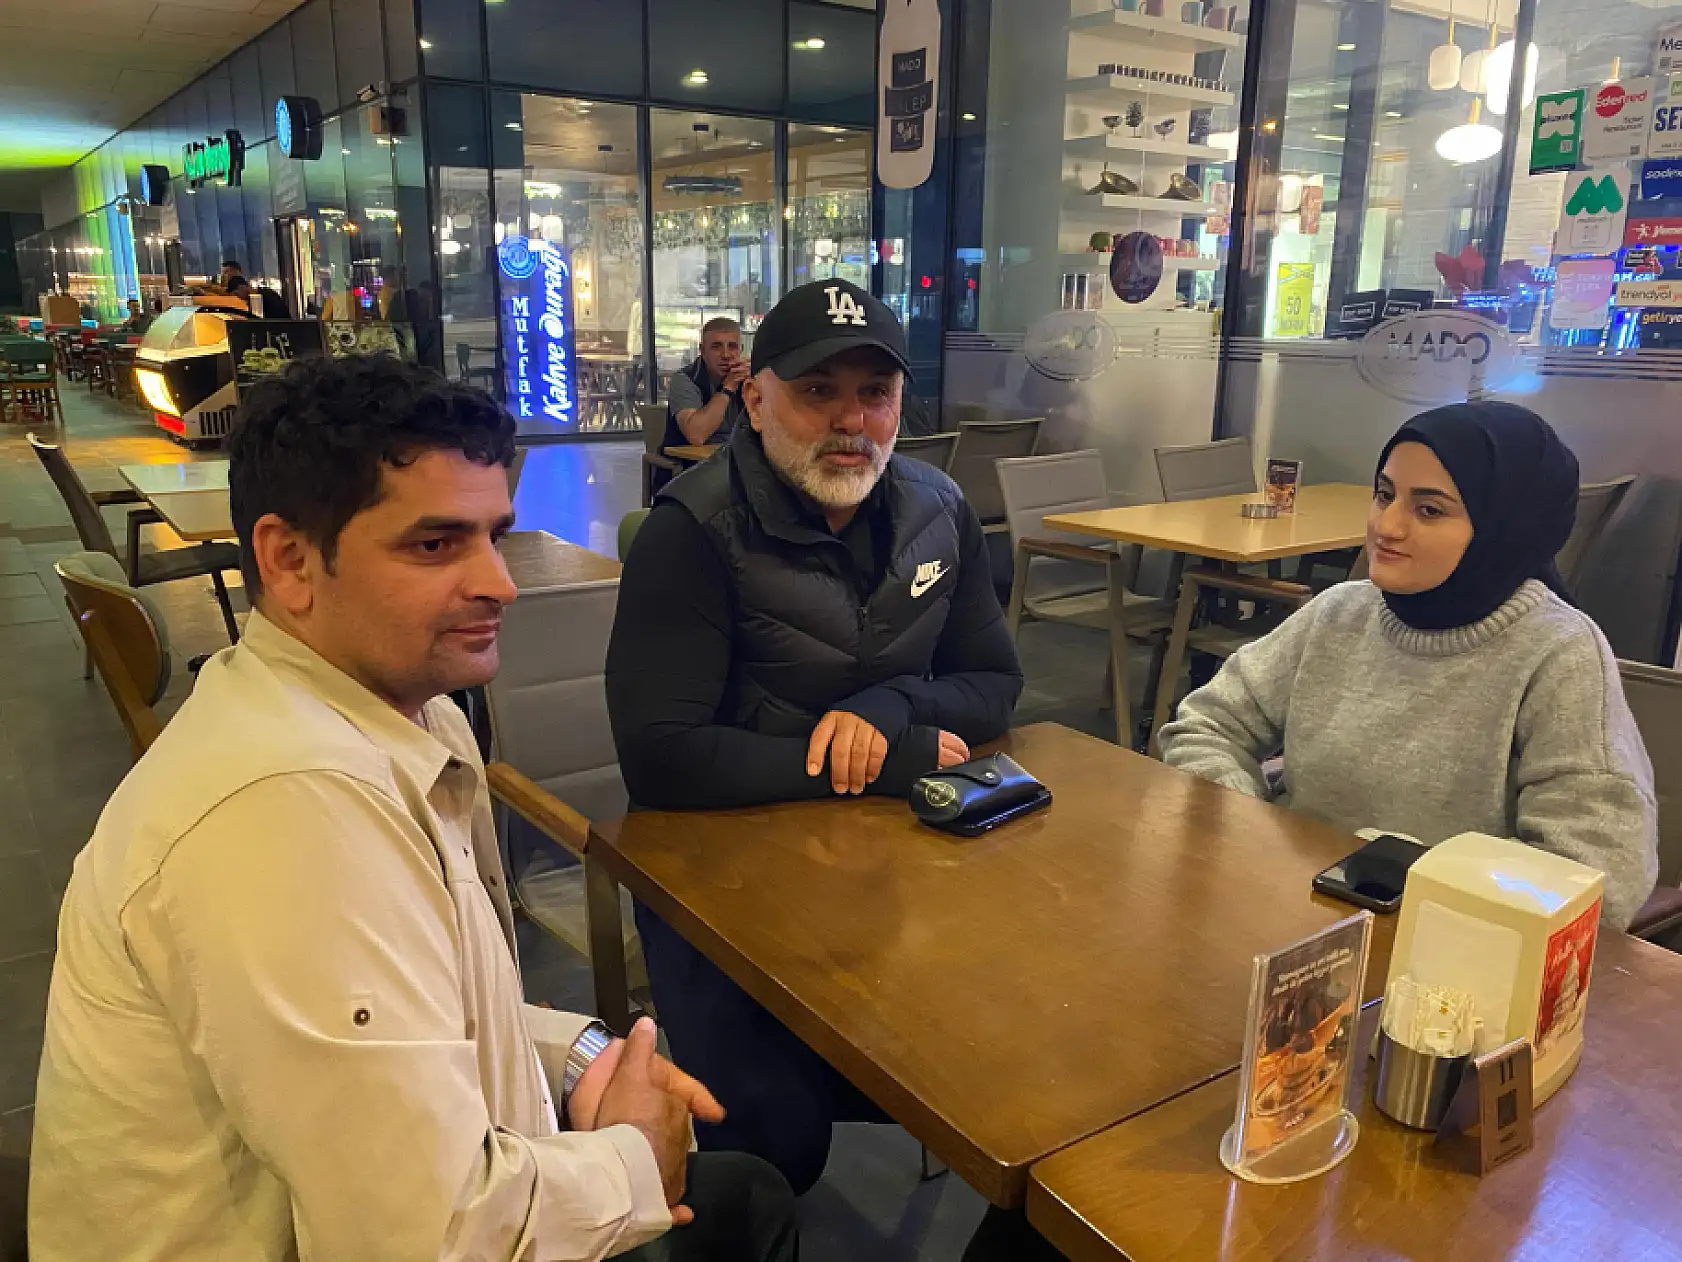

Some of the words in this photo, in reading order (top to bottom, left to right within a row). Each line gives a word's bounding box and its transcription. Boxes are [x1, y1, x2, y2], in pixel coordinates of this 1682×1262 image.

[824, 286, 868, 327] LA
[511, 295, 534, 417] Mutfak
[541, 341, 573, 423] Kahve
